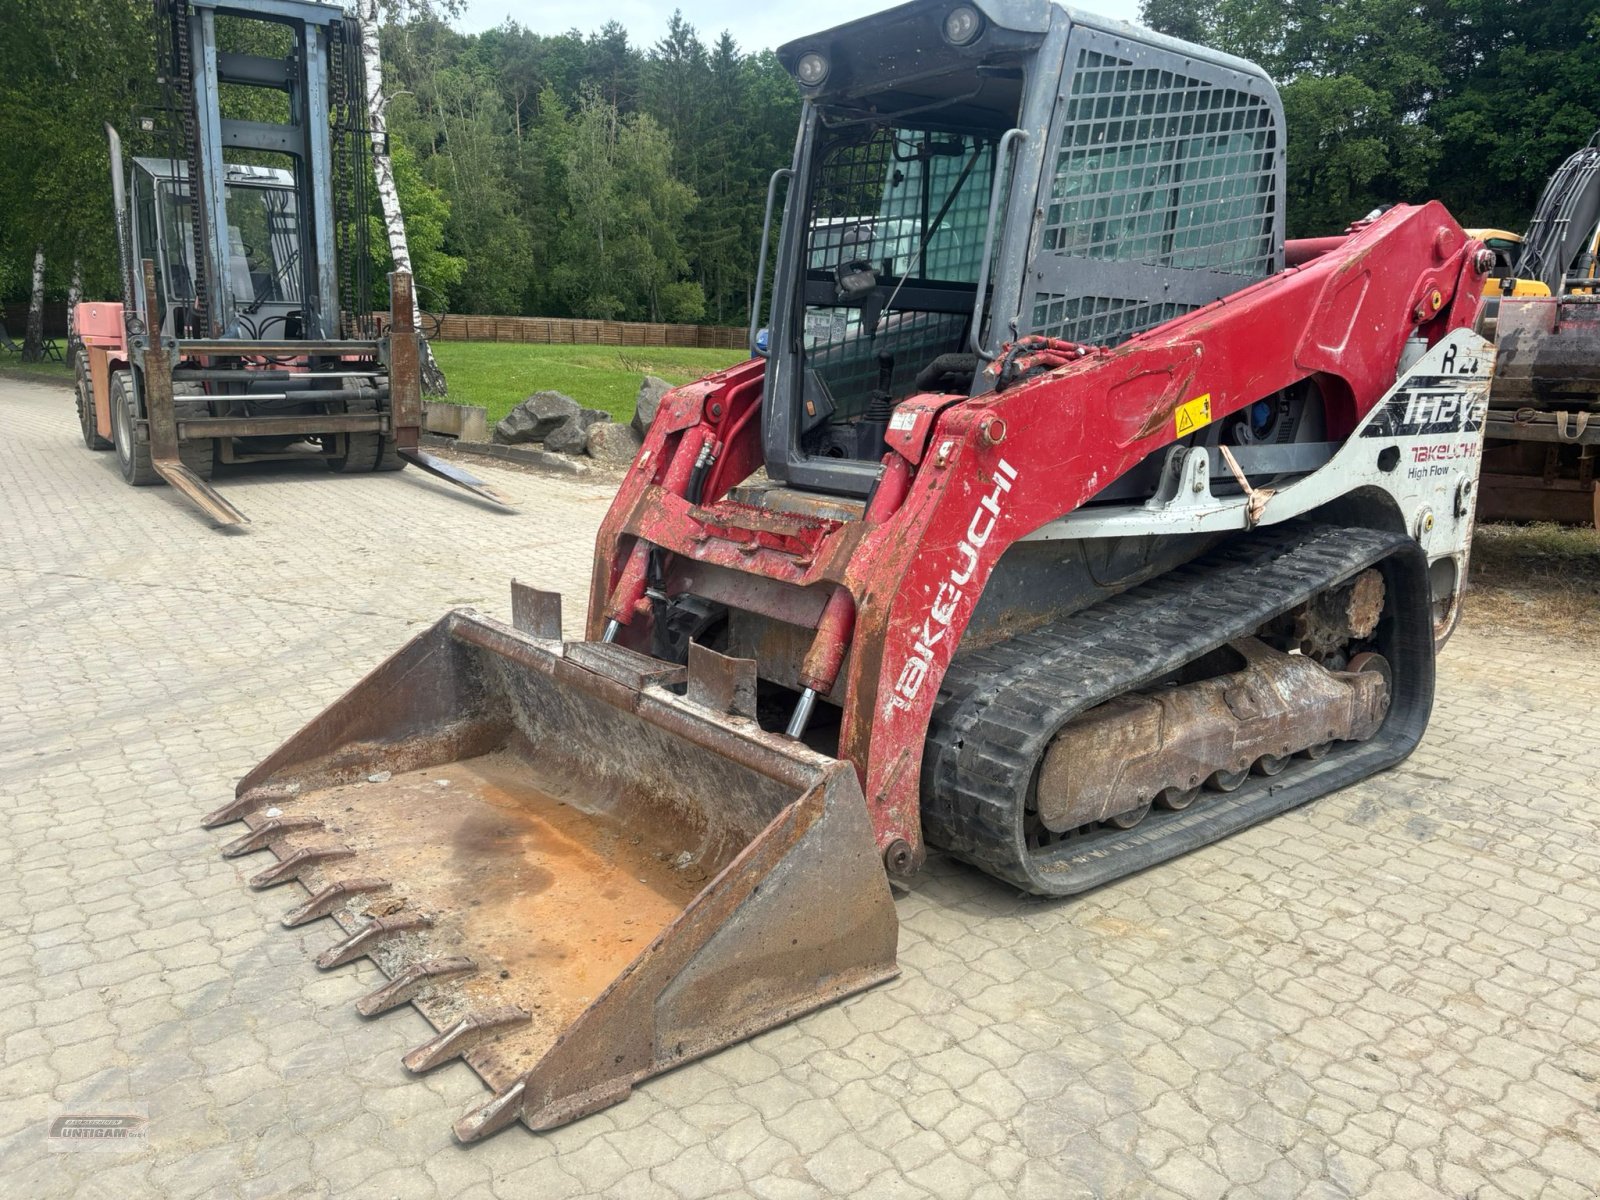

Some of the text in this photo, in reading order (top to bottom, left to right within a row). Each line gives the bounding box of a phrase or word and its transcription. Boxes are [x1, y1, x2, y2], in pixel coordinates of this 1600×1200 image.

[1441, 343, 1458, 374] R
[1407, 465, 1450, 480] High Flow
[884, 458, 1019, 723] TAKEUCHI
